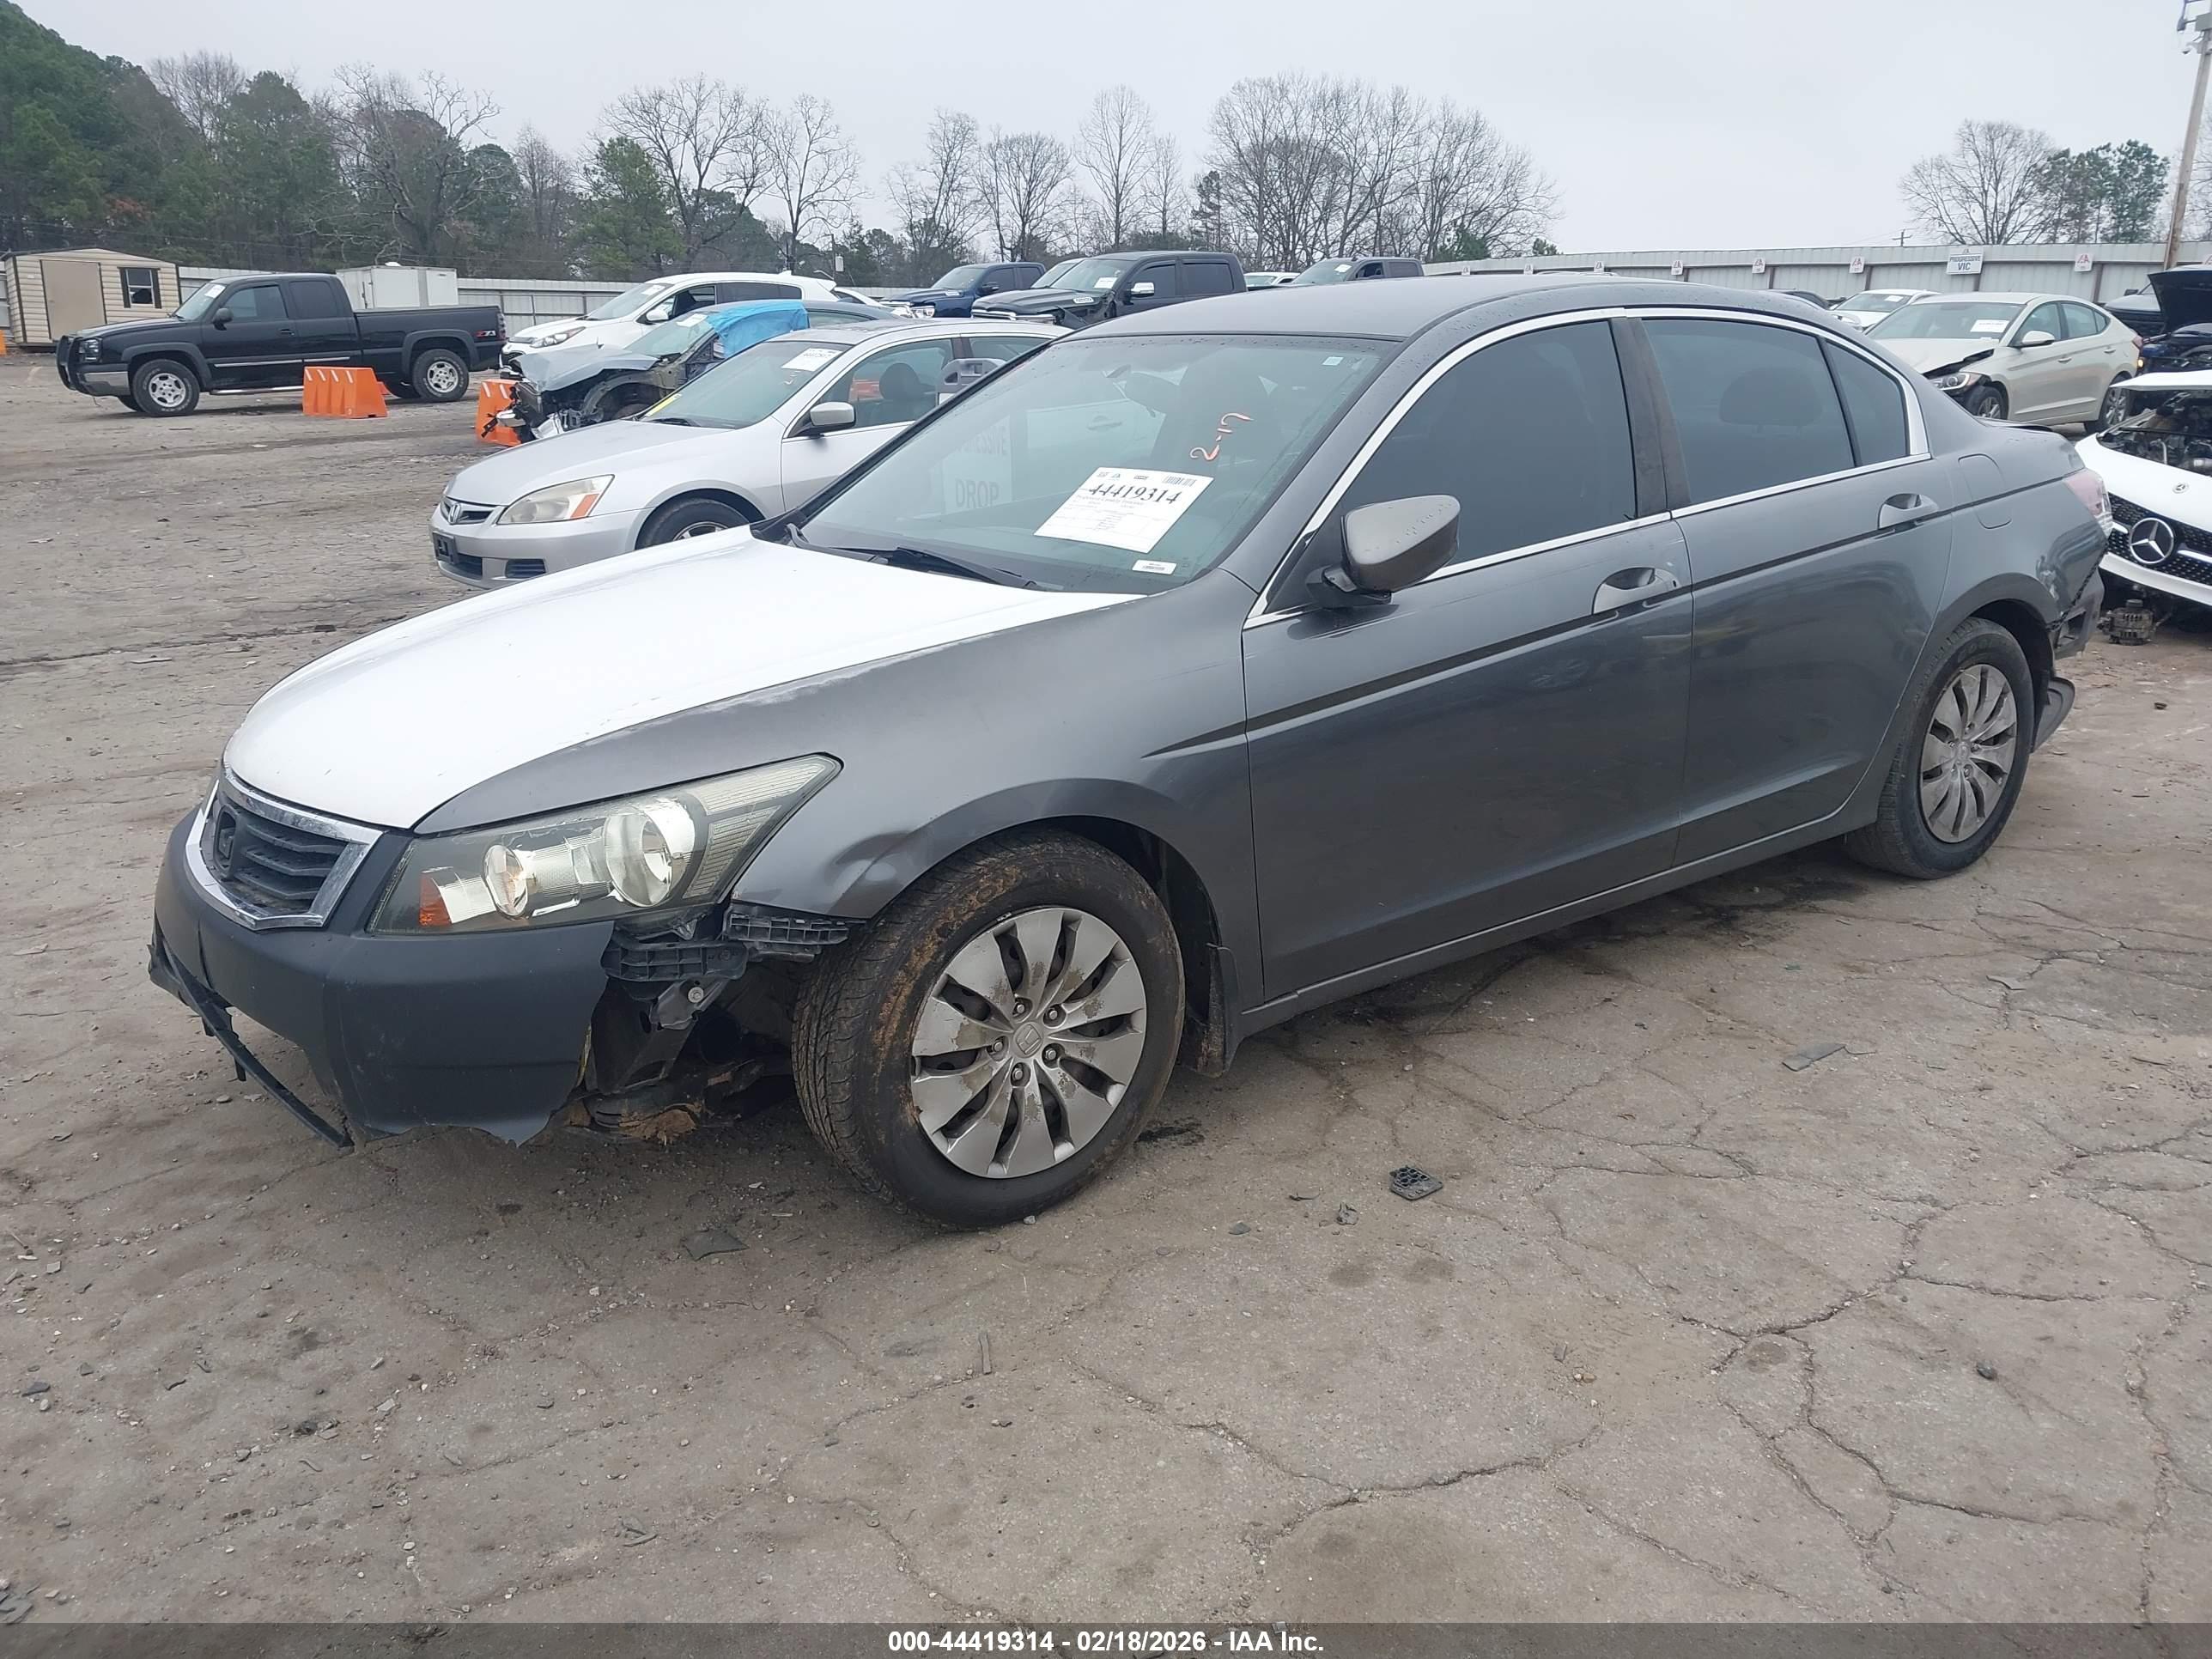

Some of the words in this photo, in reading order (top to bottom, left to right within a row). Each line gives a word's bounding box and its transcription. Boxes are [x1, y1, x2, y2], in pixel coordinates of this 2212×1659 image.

[1958, 262, 1972, 271] VIC
[955, 477, 1001, 508] DROP
[1089, 483, 1182, 505] 44419314
